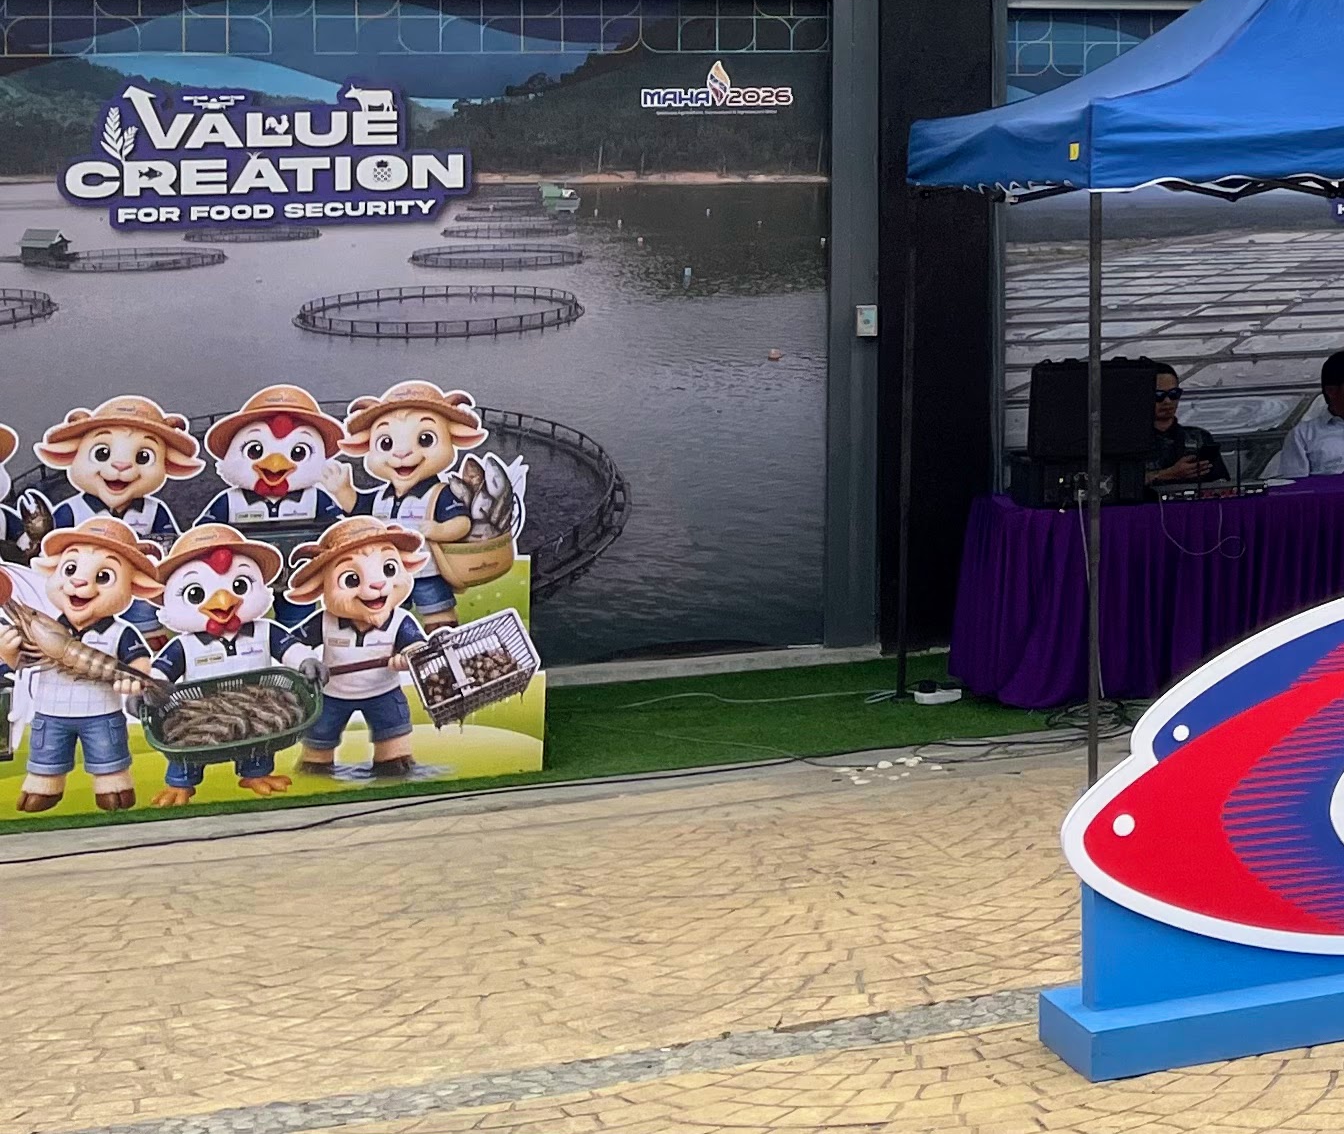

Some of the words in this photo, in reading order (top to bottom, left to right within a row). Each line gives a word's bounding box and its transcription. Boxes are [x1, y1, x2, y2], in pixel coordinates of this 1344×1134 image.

[641, 88, 711, 107] MAHA
[726, 87, 794, 107] 2026
[122, 88, 399, 150] VALUE
[64, 153, 465, 199] CREATION
[117, 206, 181, 224] FOR
[189, 204, 275, 221] FOOD
[284, 199, 436, 219] SECURITY
